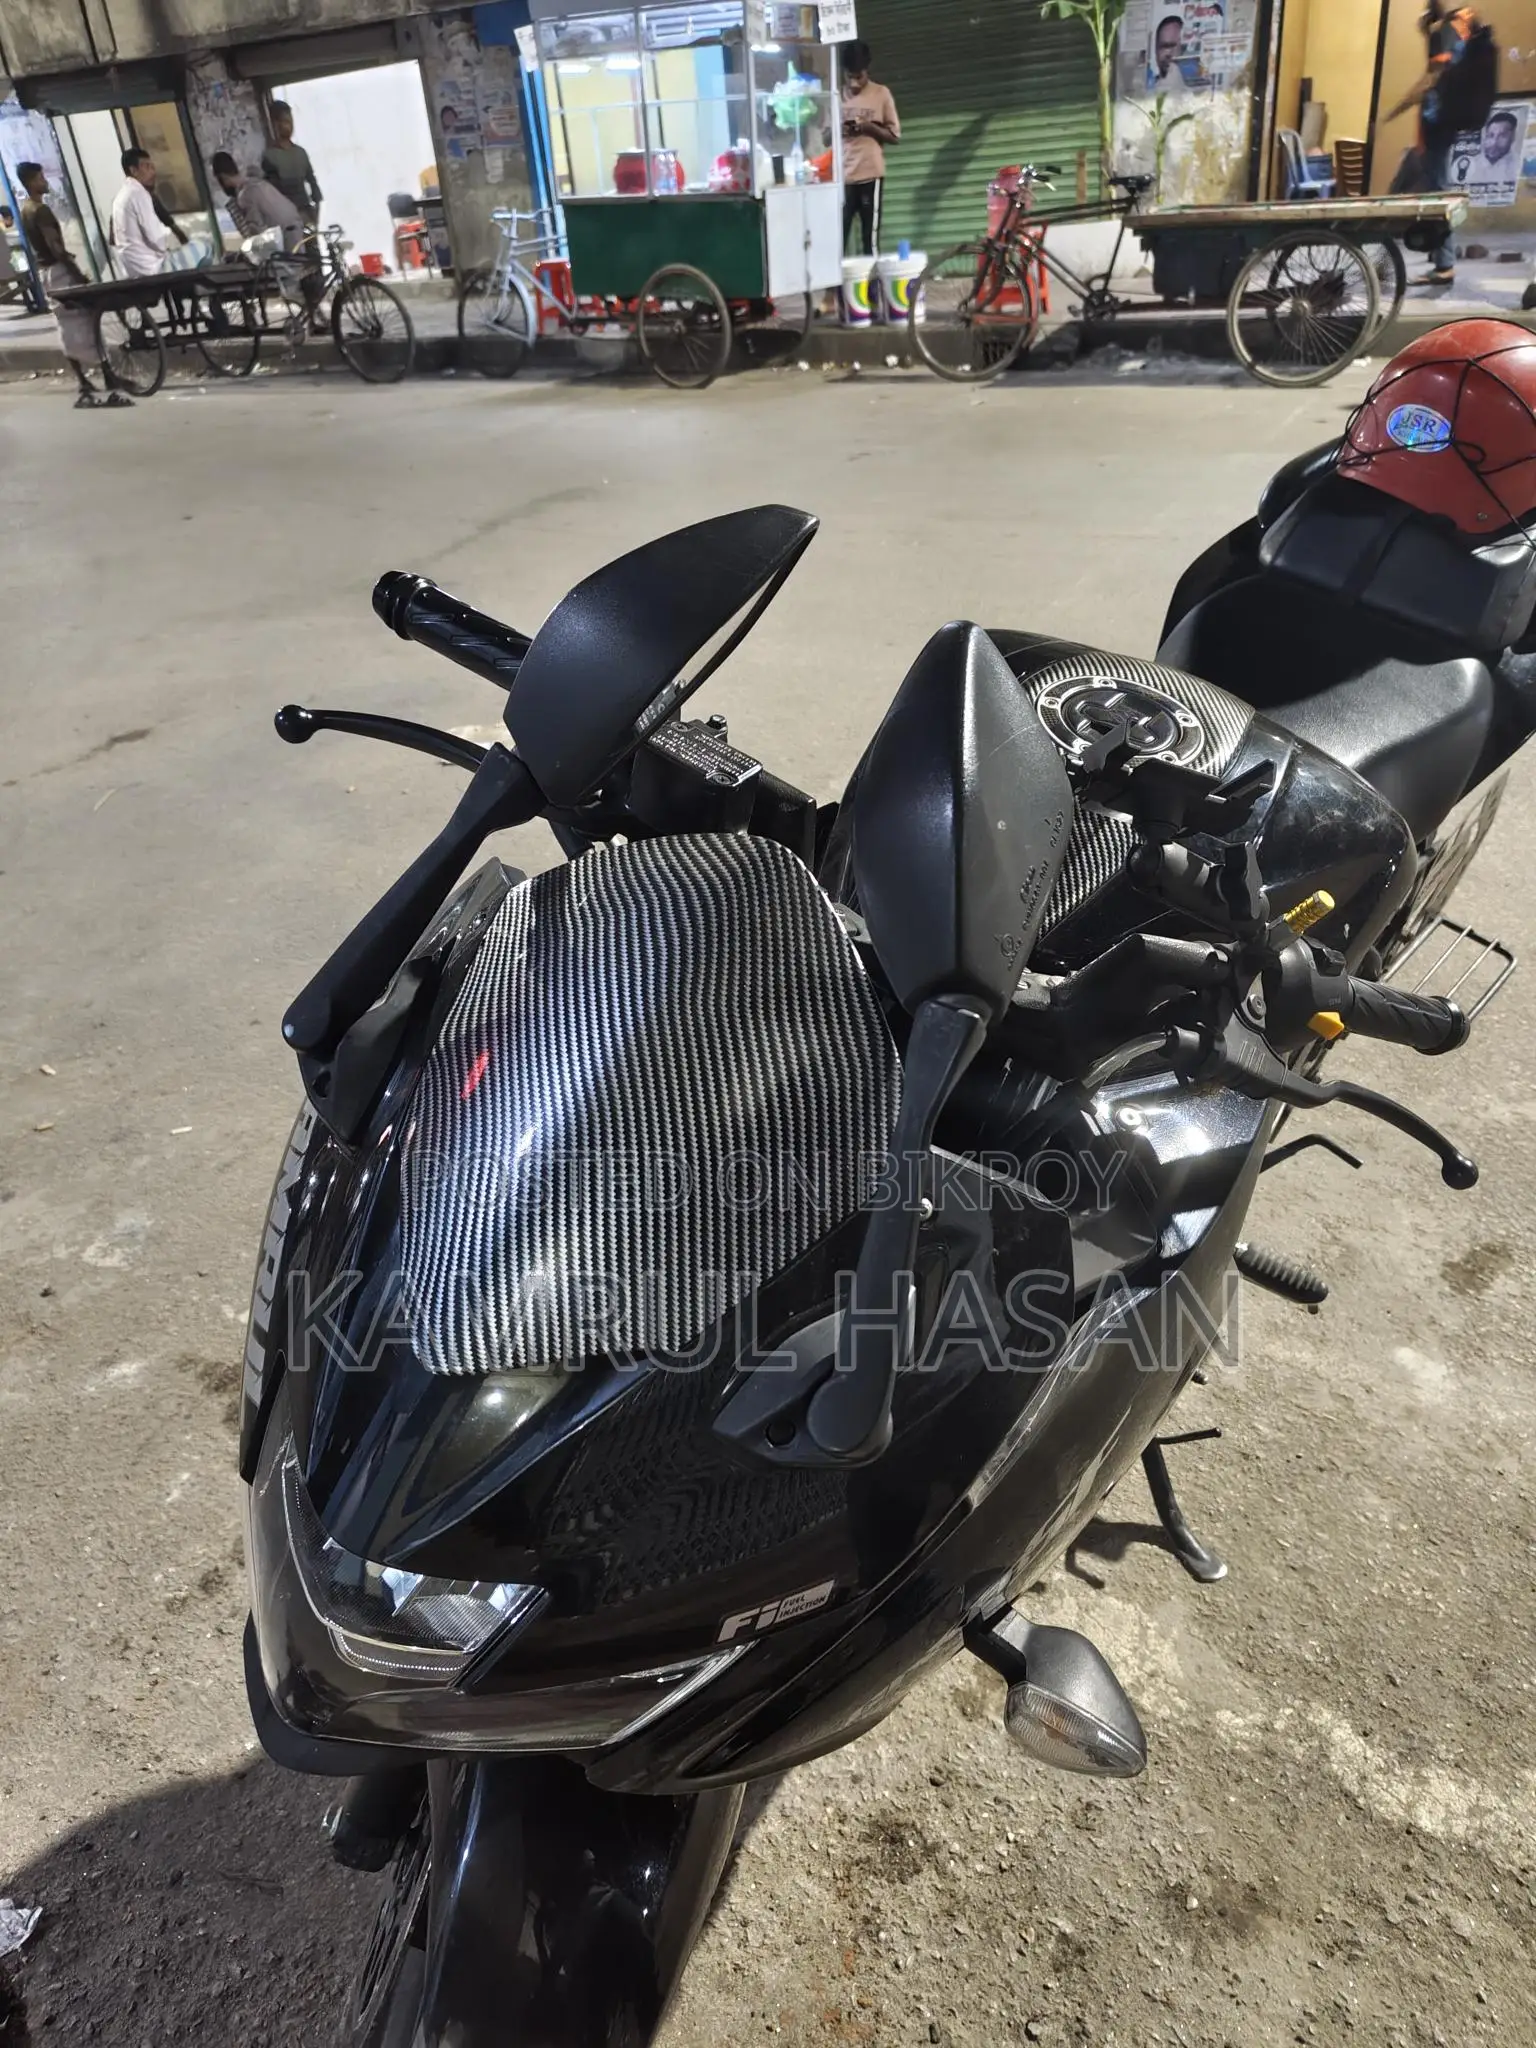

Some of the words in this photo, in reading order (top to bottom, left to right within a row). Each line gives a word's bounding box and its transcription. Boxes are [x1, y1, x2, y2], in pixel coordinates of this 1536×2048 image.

[1401, 410, 1437, 433] JSR
[780, 1595, 827, 1619] INJECTION
[783, 1594, 806, 1608] FUEL
[717, 1600, 781, 1643] Fi
